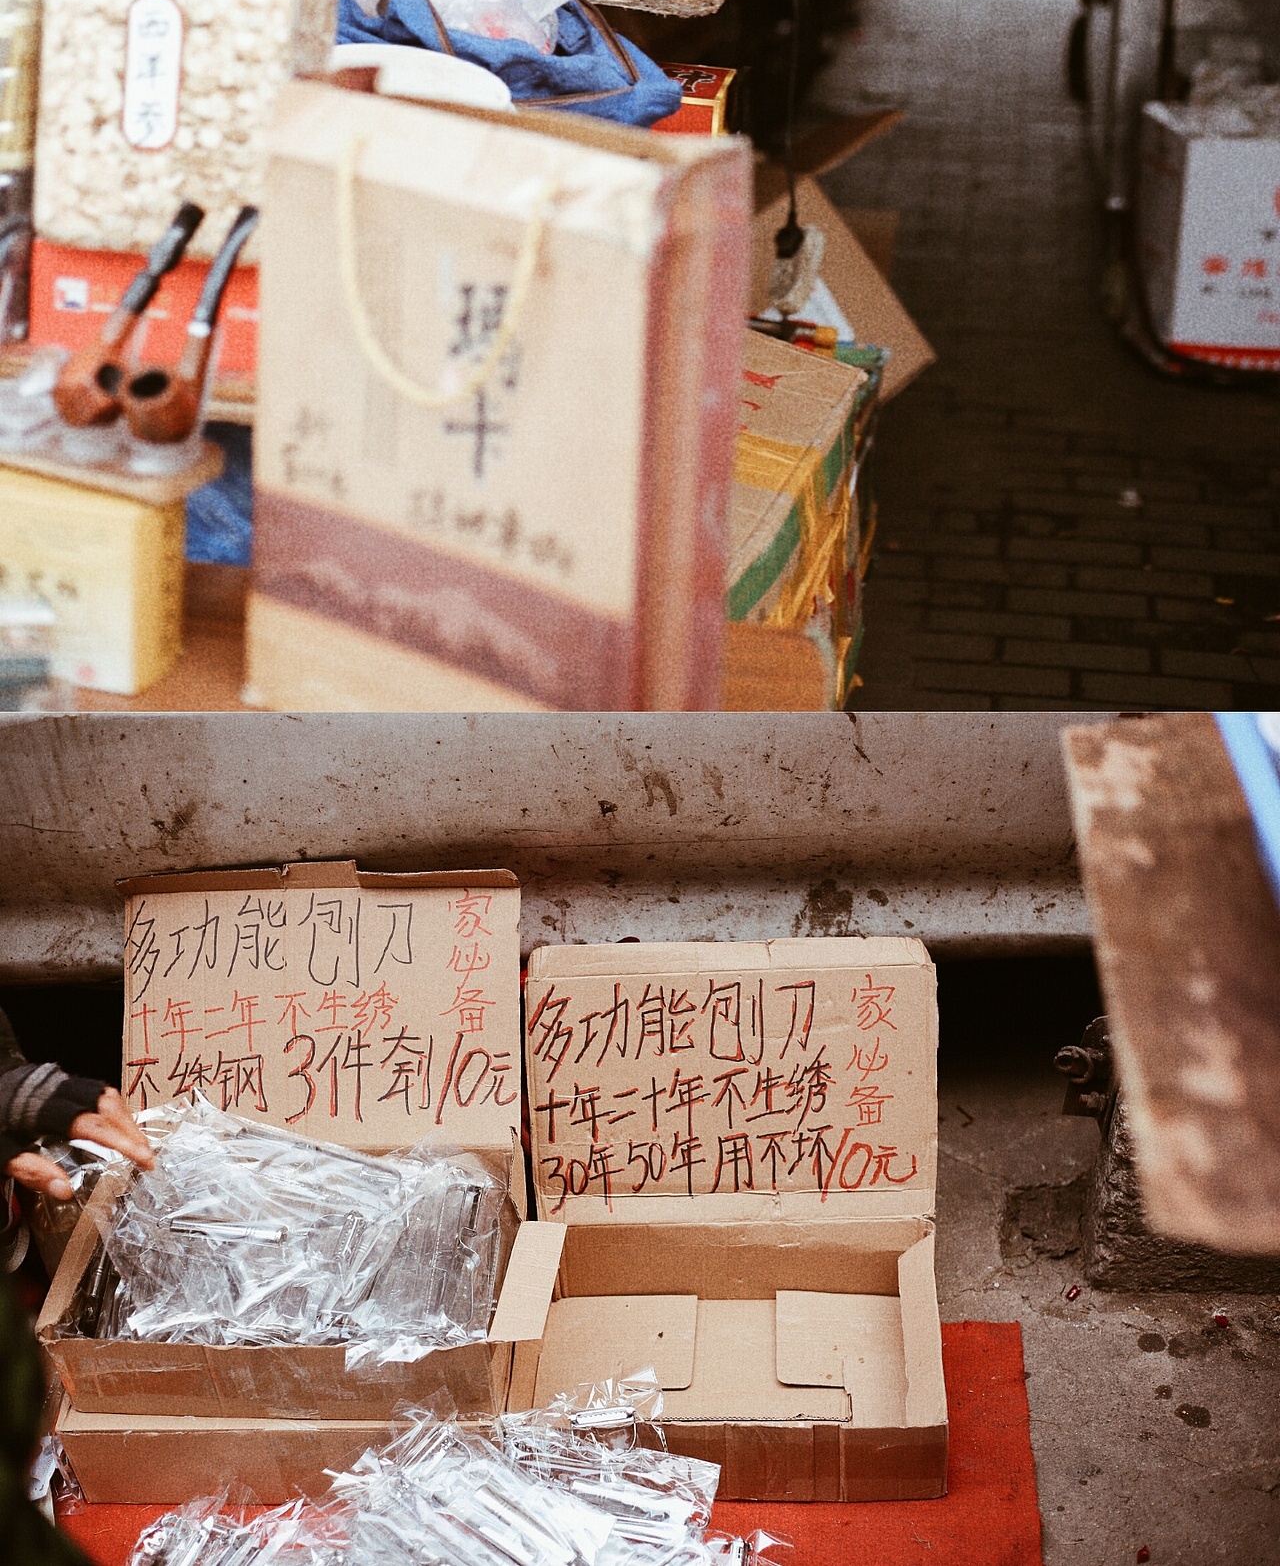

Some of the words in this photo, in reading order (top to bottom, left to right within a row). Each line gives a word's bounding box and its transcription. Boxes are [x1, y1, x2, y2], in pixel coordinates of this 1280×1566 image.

[124, 891, 415, 1004] 多功能刨刀
[438, 888, 497, 1035] 家必备
[527, 978, 817, 1084] 多功能刨刀
[844, 973, 899, 1127] 家必备
[535, 1044, 837, 1145] 十年二十年不生绣
